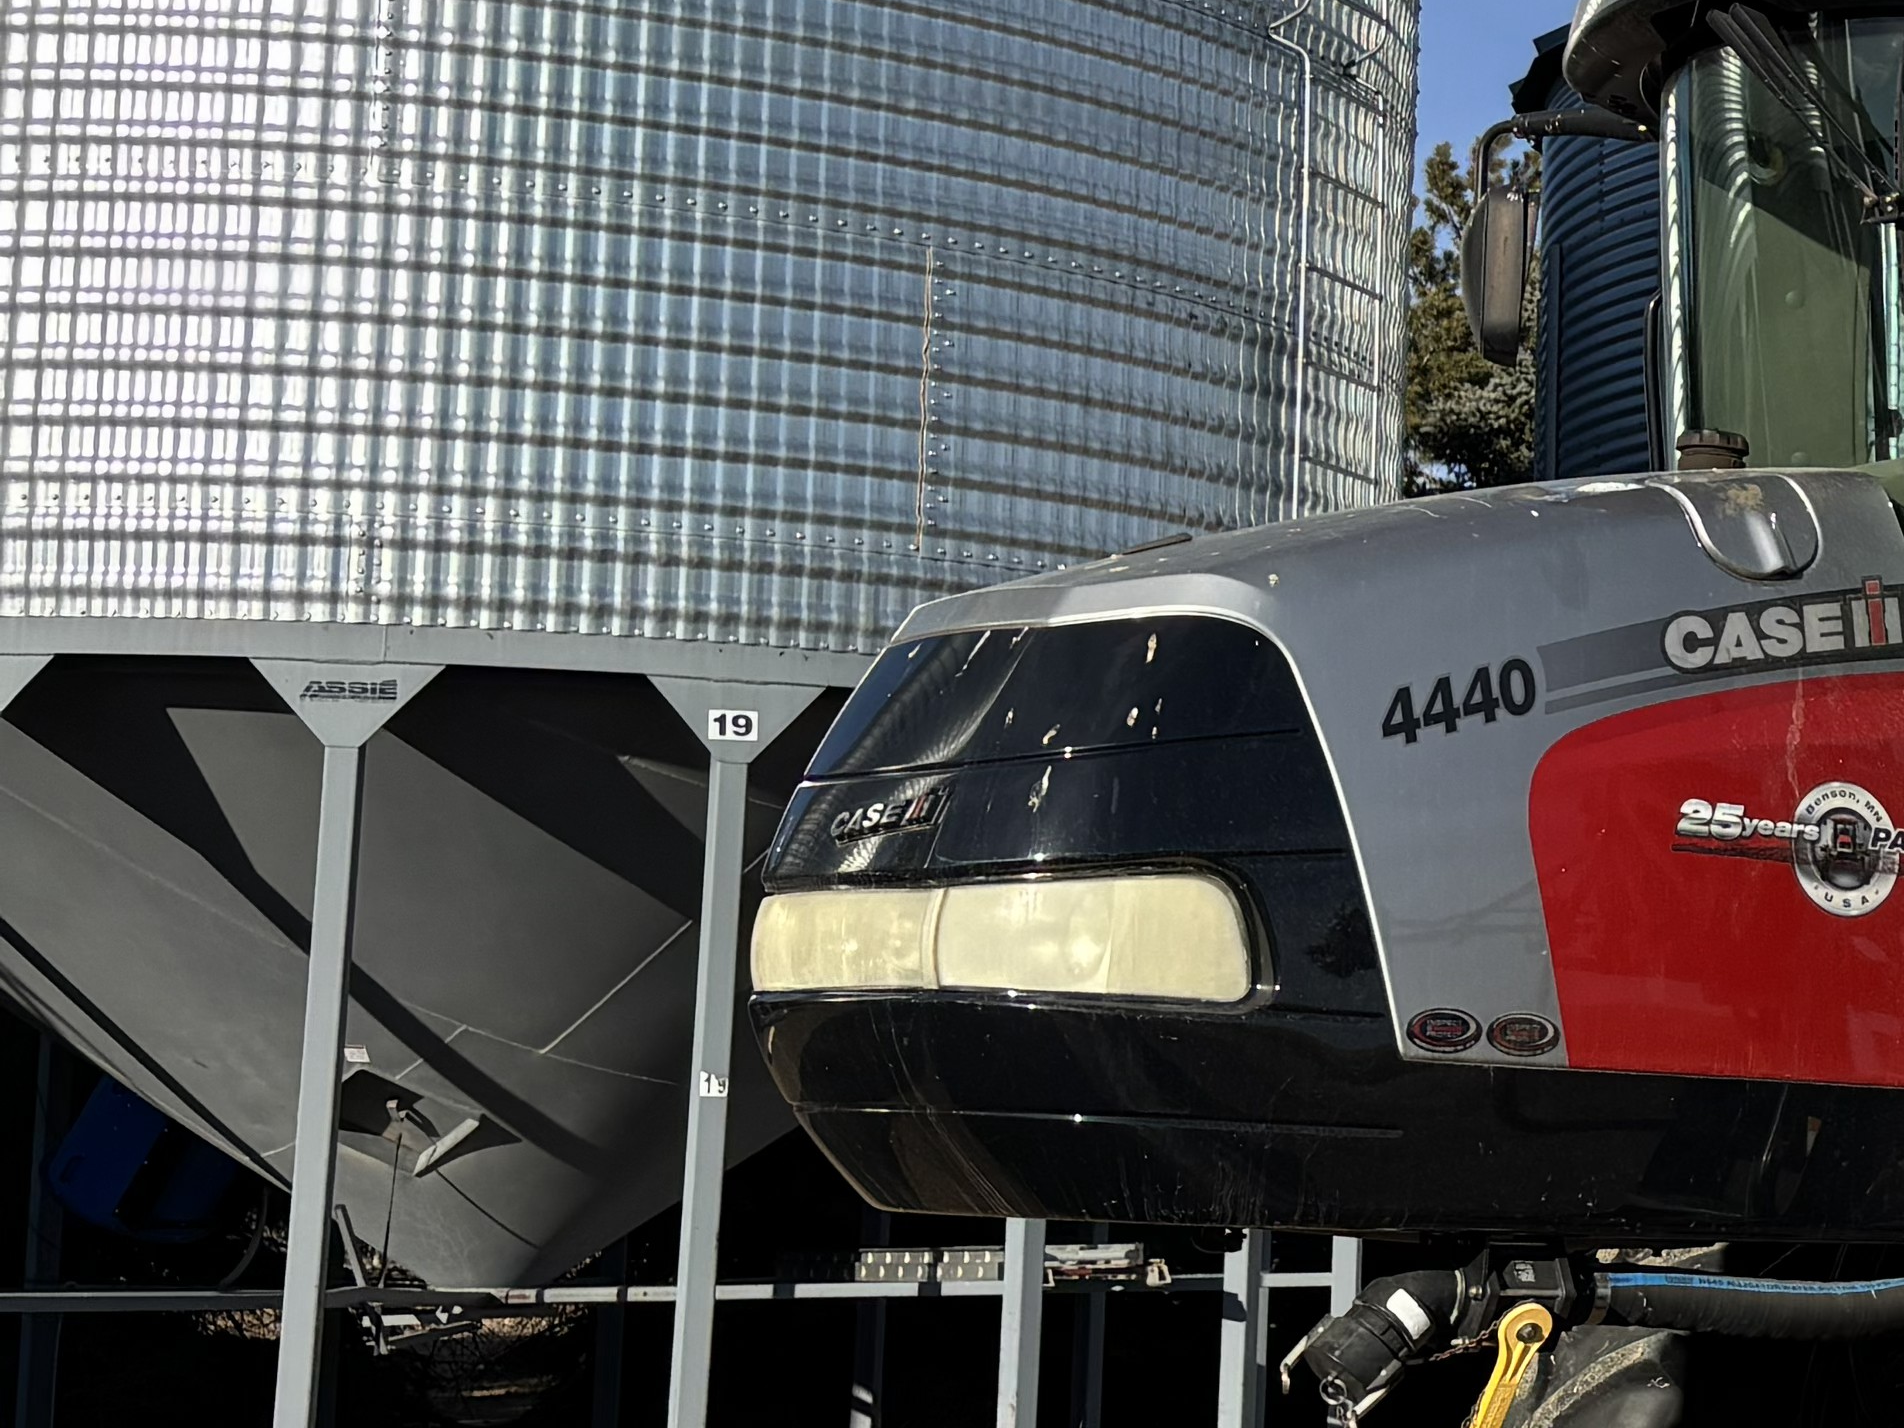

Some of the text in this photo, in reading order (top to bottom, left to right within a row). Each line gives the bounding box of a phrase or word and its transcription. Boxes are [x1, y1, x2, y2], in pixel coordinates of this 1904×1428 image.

[1382, 658, 1537, 744] 4440
[713, 713, 753, 737] 19
[704, 1073, 727, 1094] 19
